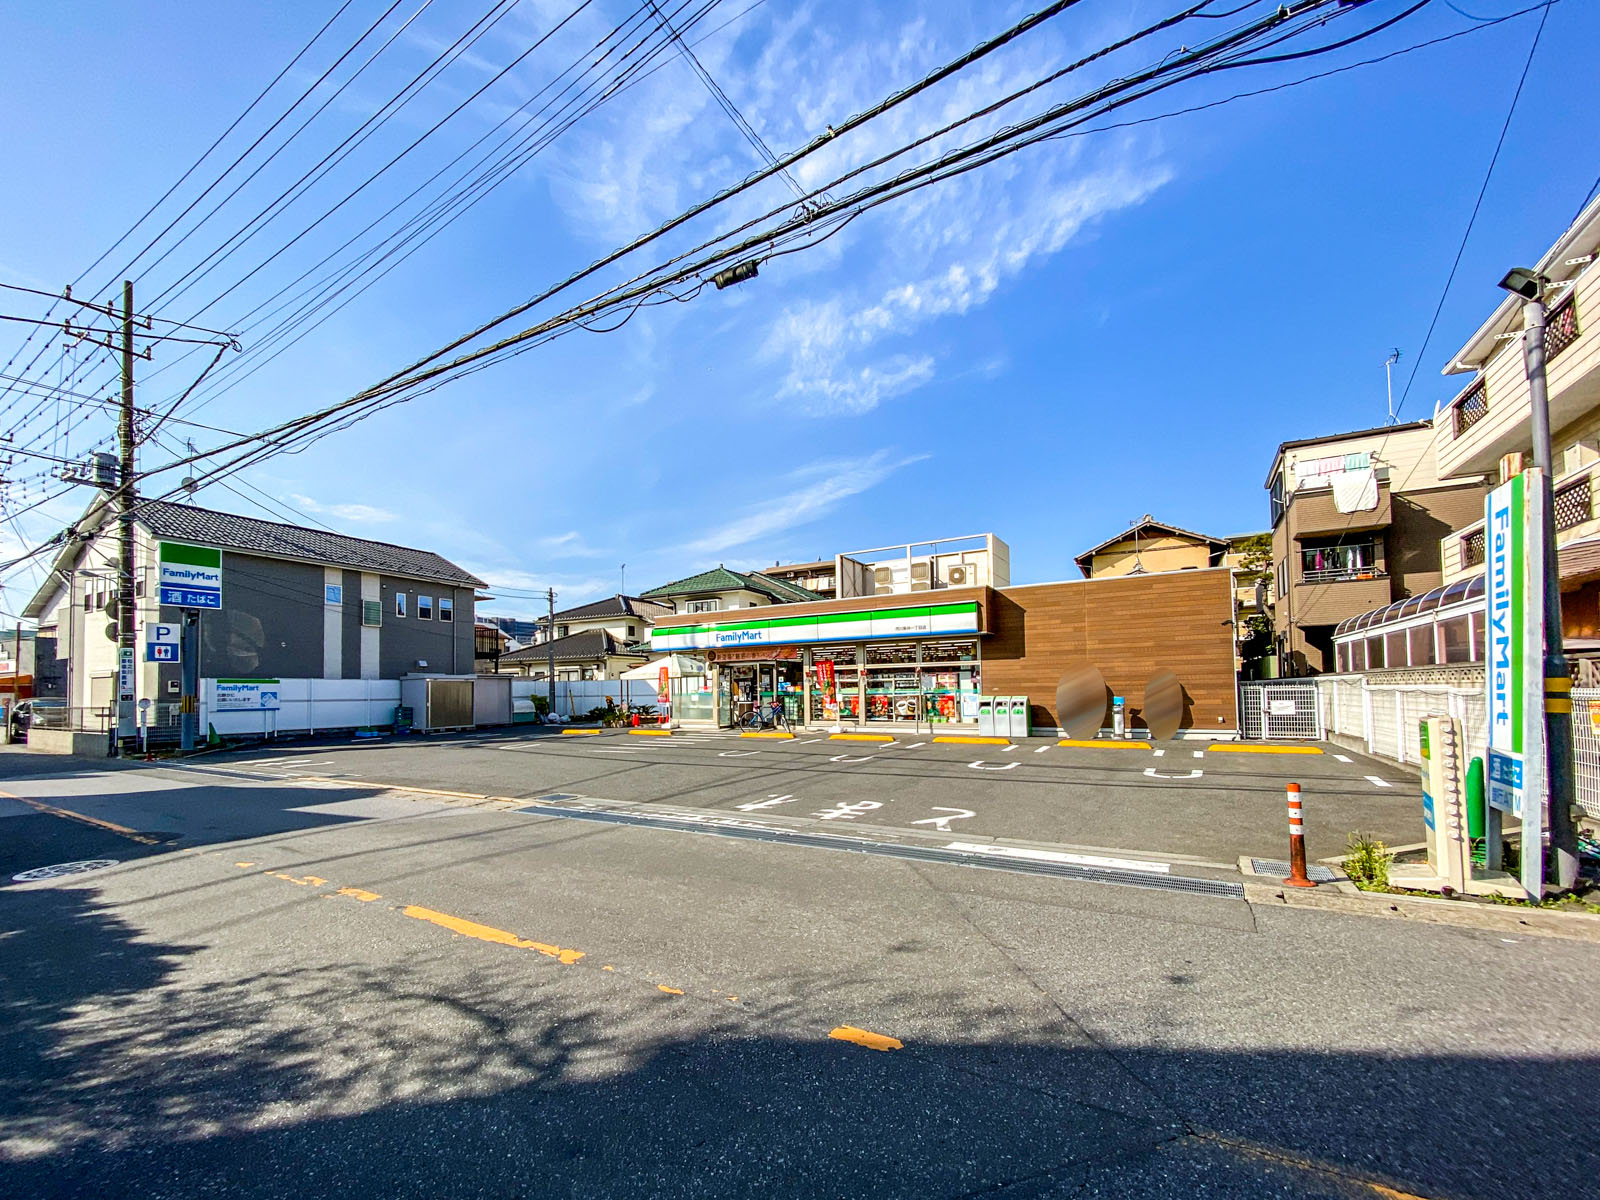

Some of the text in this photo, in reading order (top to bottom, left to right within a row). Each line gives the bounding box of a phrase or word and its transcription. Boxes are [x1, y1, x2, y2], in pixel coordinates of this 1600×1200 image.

[162, 567, 219, 581] FamilyMart
[168, 591, 216, 605] 酒 たばこ
[1492, 506, 1509, 726] FamilyMart
[156, 626, 171, 640] P
[715, 630, 762, 643] FamilyMart
[216, 684, 260, 692] FamilyMart
